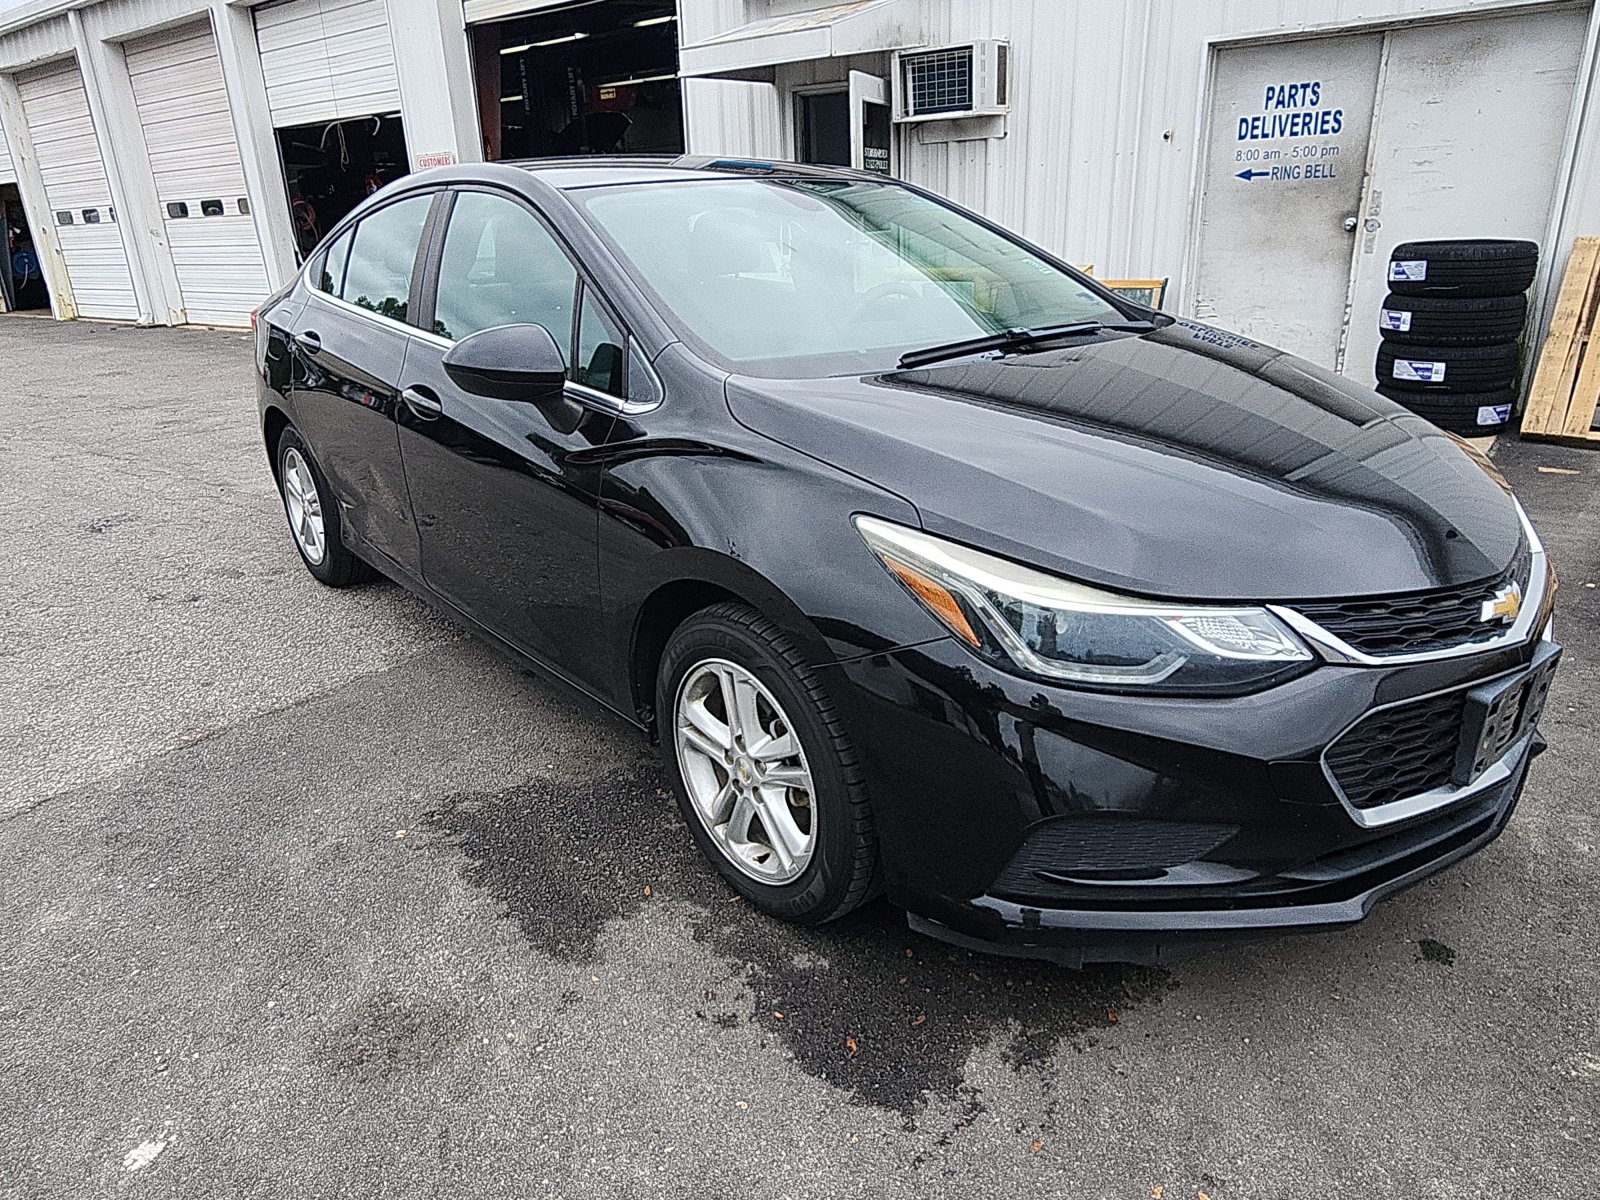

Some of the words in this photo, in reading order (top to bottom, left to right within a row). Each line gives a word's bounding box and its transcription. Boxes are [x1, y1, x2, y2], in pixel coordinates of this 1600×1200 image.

[1264, 82, 1321, 110] PARTS
[1238, 109, 1343, 140] DELIVERIES
[419, 156, 451, 168] CUSTOMERS
[1235, 149, 1260, 162] 8:00
[1263, 150, 1281, 160] am
[1292, 145, 1317, 158] 5:00
[1320, 145, 1340, 158] pm
[1271, 165, 1301, 181] RING
[1304, 163, 1336, 179] BELL
